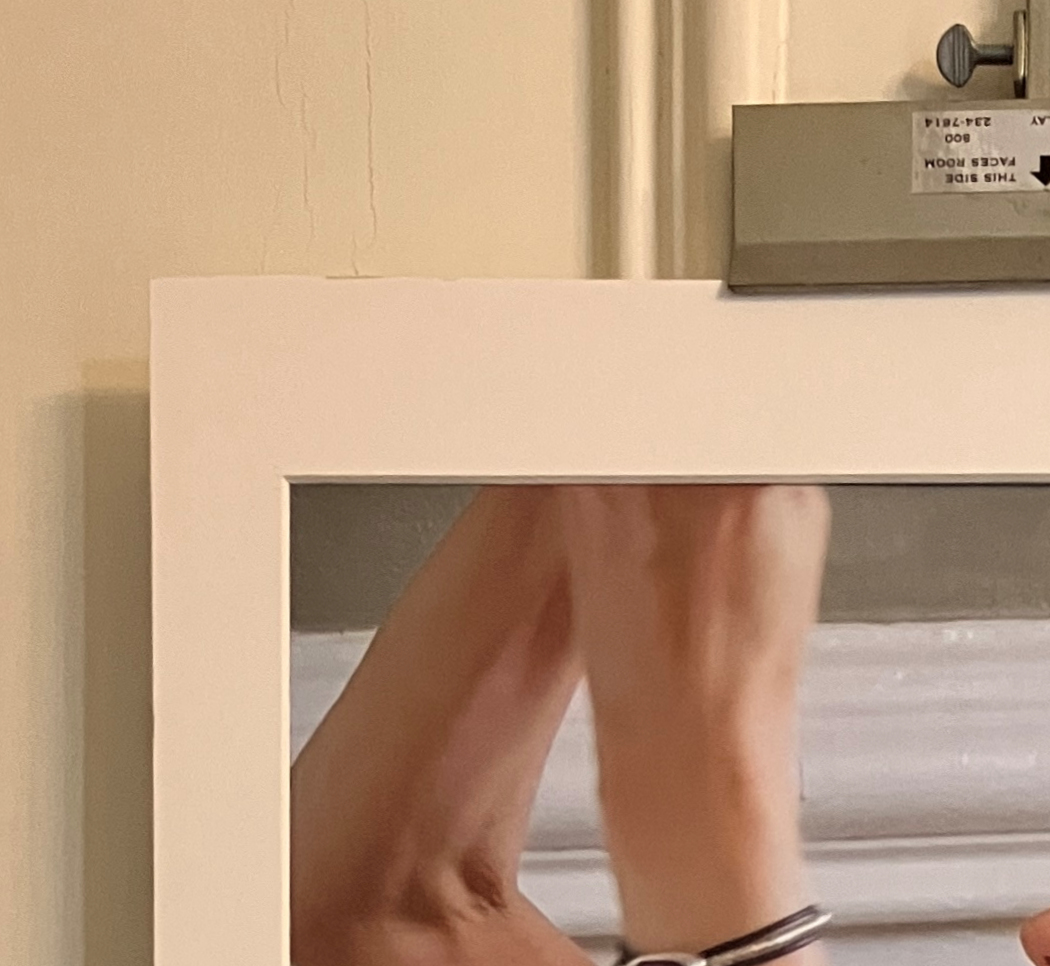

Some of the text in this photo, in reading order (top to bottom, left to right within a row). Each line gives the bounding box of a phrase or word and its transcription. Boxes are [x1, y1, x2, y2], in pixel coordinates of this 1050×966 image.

[945, 133, 970, 143] 800
[924, 157, 1016, 168] FACES ROOM
[946, 173, 1016, 184] THIS SIDE
